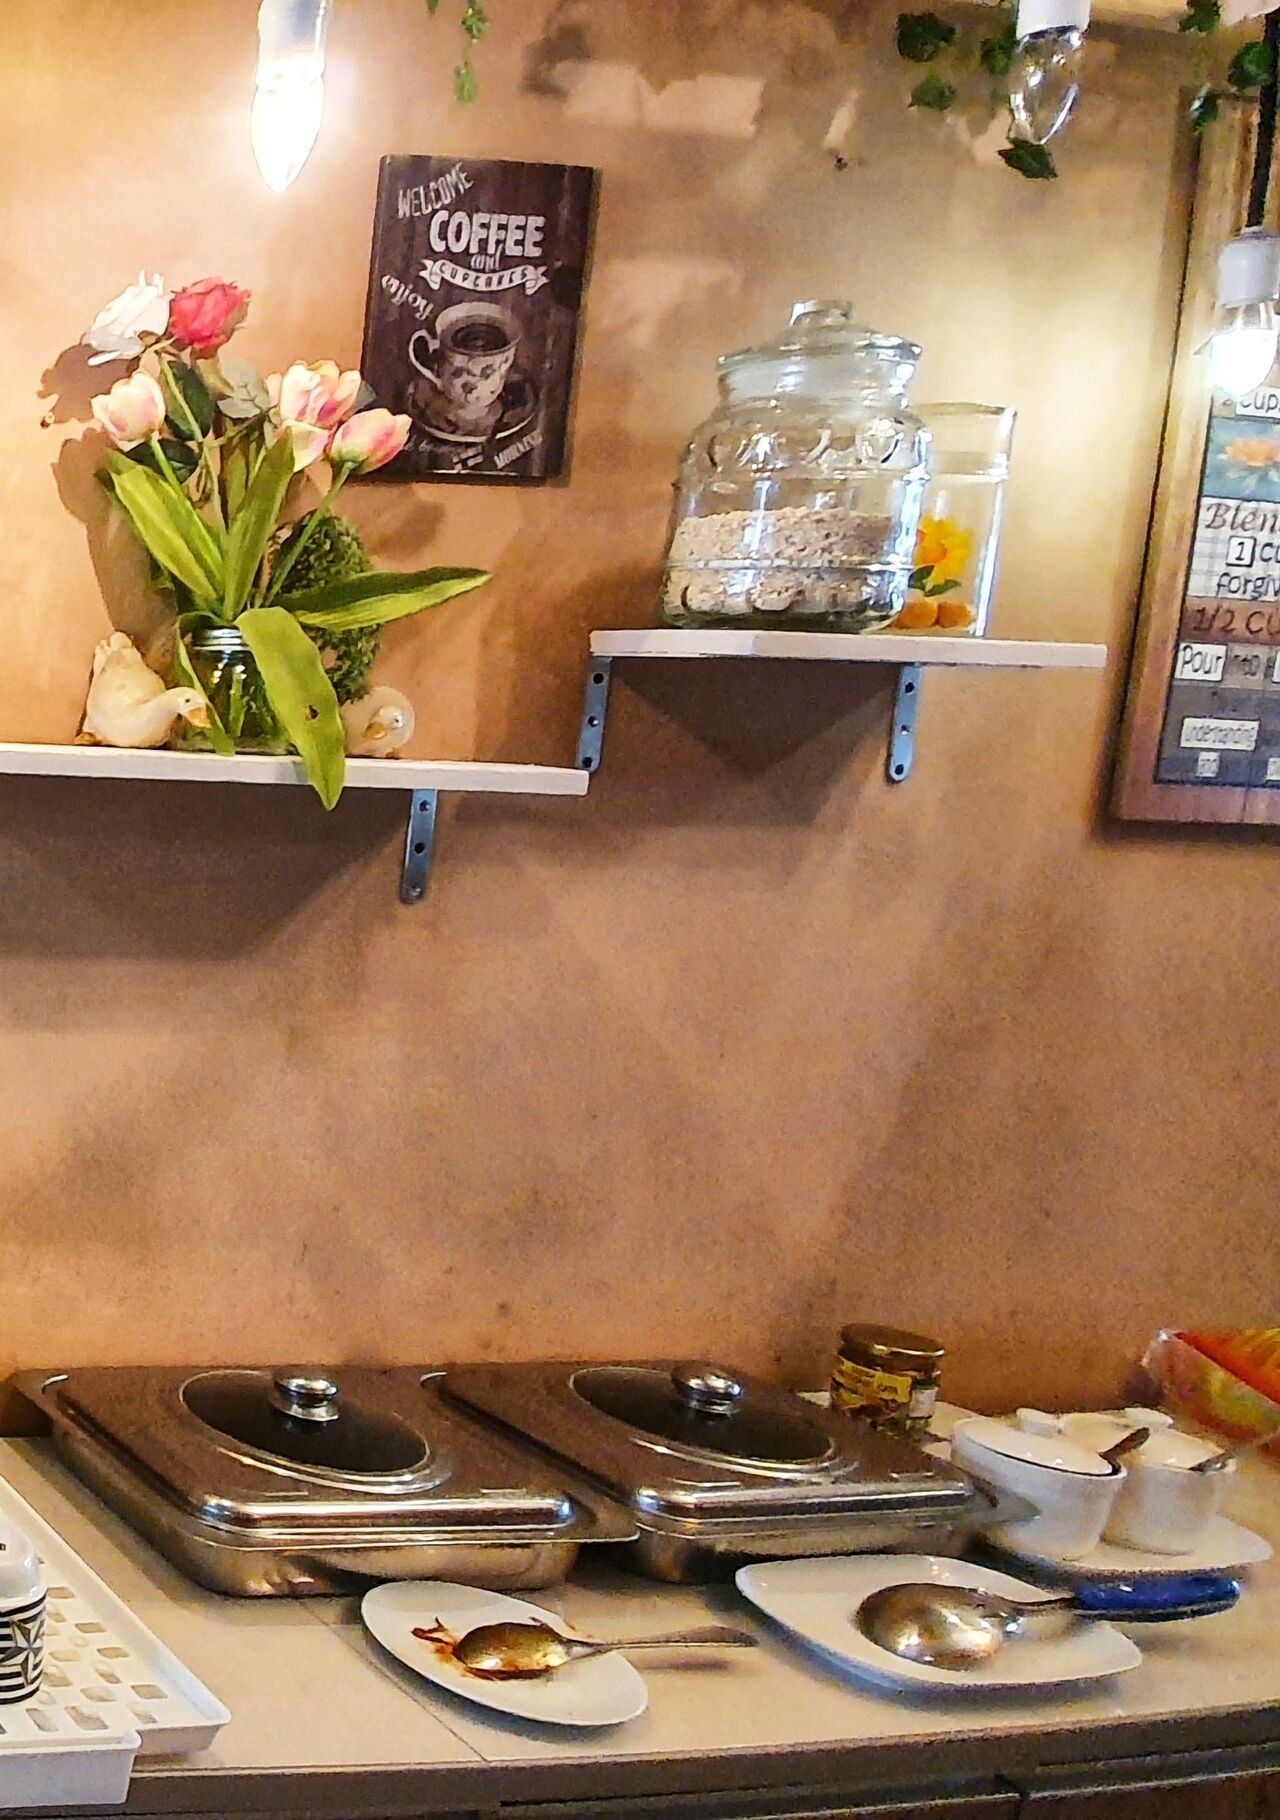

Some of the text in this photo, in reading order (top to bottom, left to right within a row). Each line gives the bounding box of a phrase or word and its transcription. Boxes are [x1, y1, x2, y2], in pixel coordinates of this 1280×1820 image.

[397, 162, 474, 219] WELCOME
[429, 210, 546, 257] COFFEE
[470, 244, 504, 271] and
[439, 262, 528, 289] CUPCAKES
[1205, 502, 1280, 534] Blen
[1180, 645, 1223, 676] Pour
